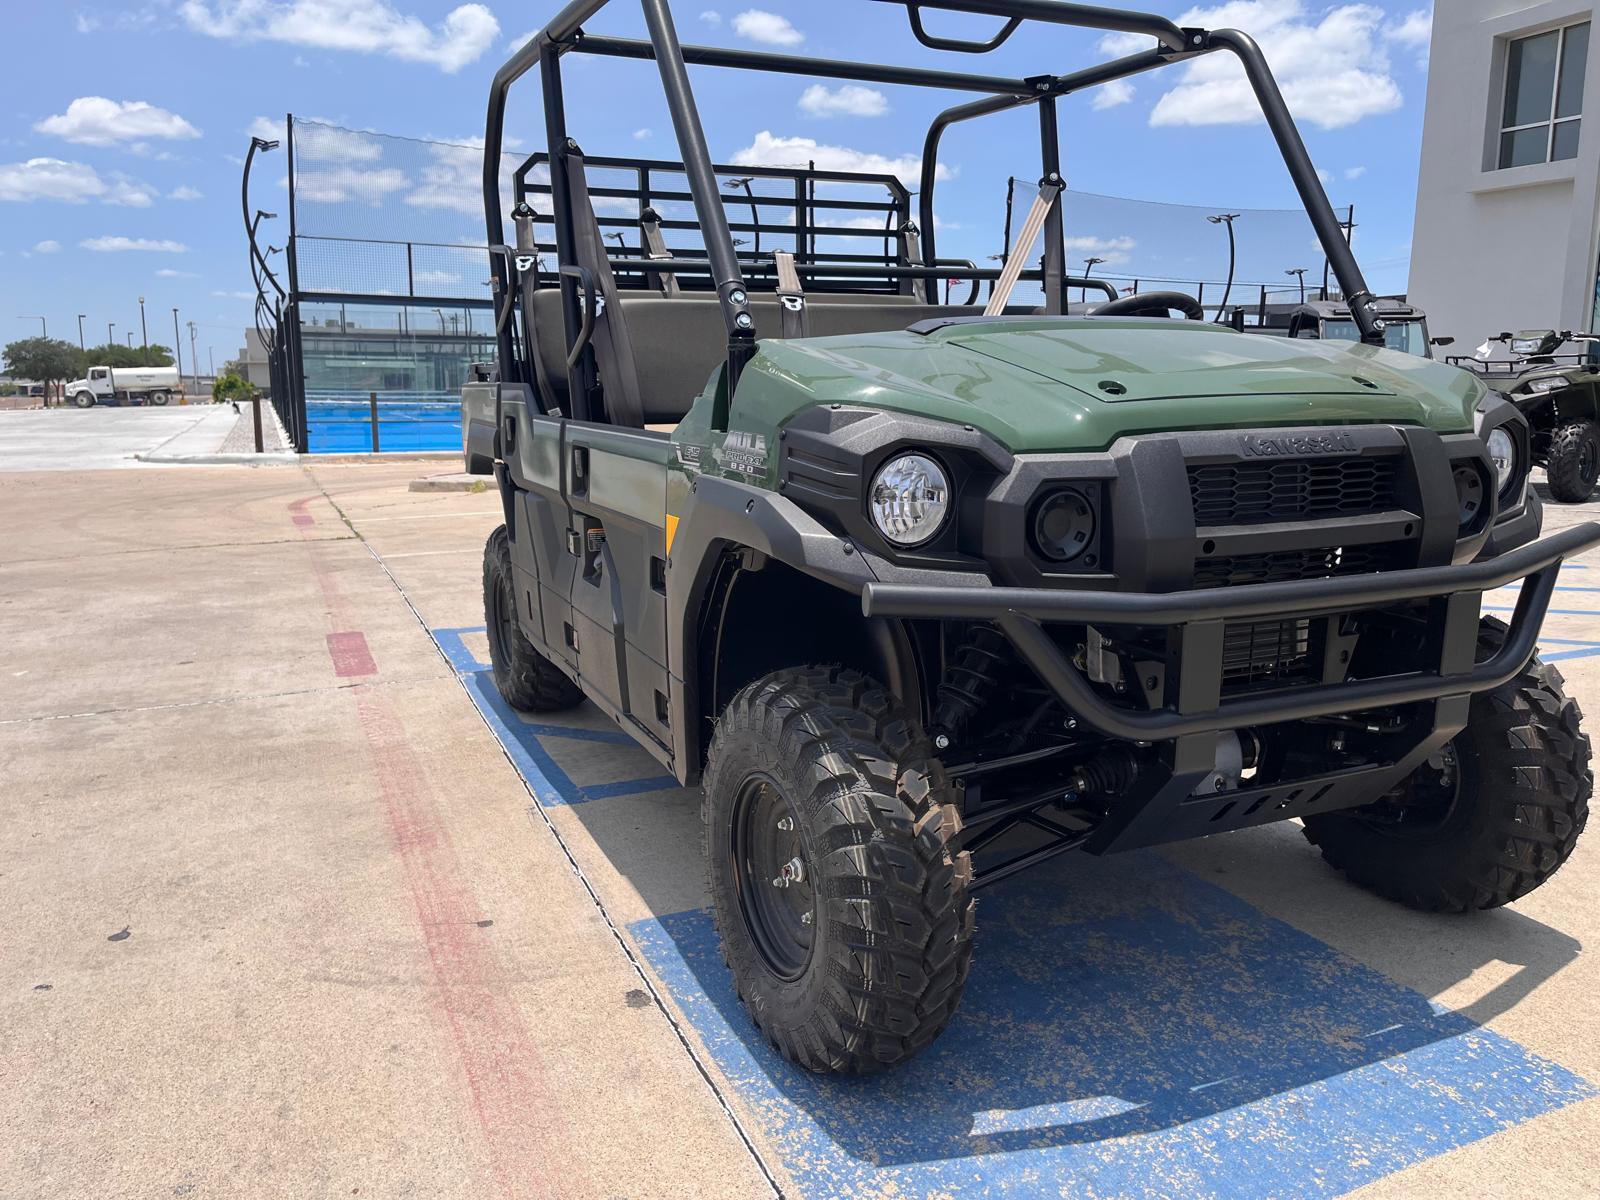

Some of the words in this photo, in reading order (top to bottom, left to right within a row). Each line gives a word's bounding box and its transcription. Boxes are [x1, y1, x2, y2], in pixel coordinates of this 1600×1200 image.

[722, 430, 768, 458] MULE
[1238, 432, 1357, 457] Kawasaki
[730, 462, 754, 474] 820
